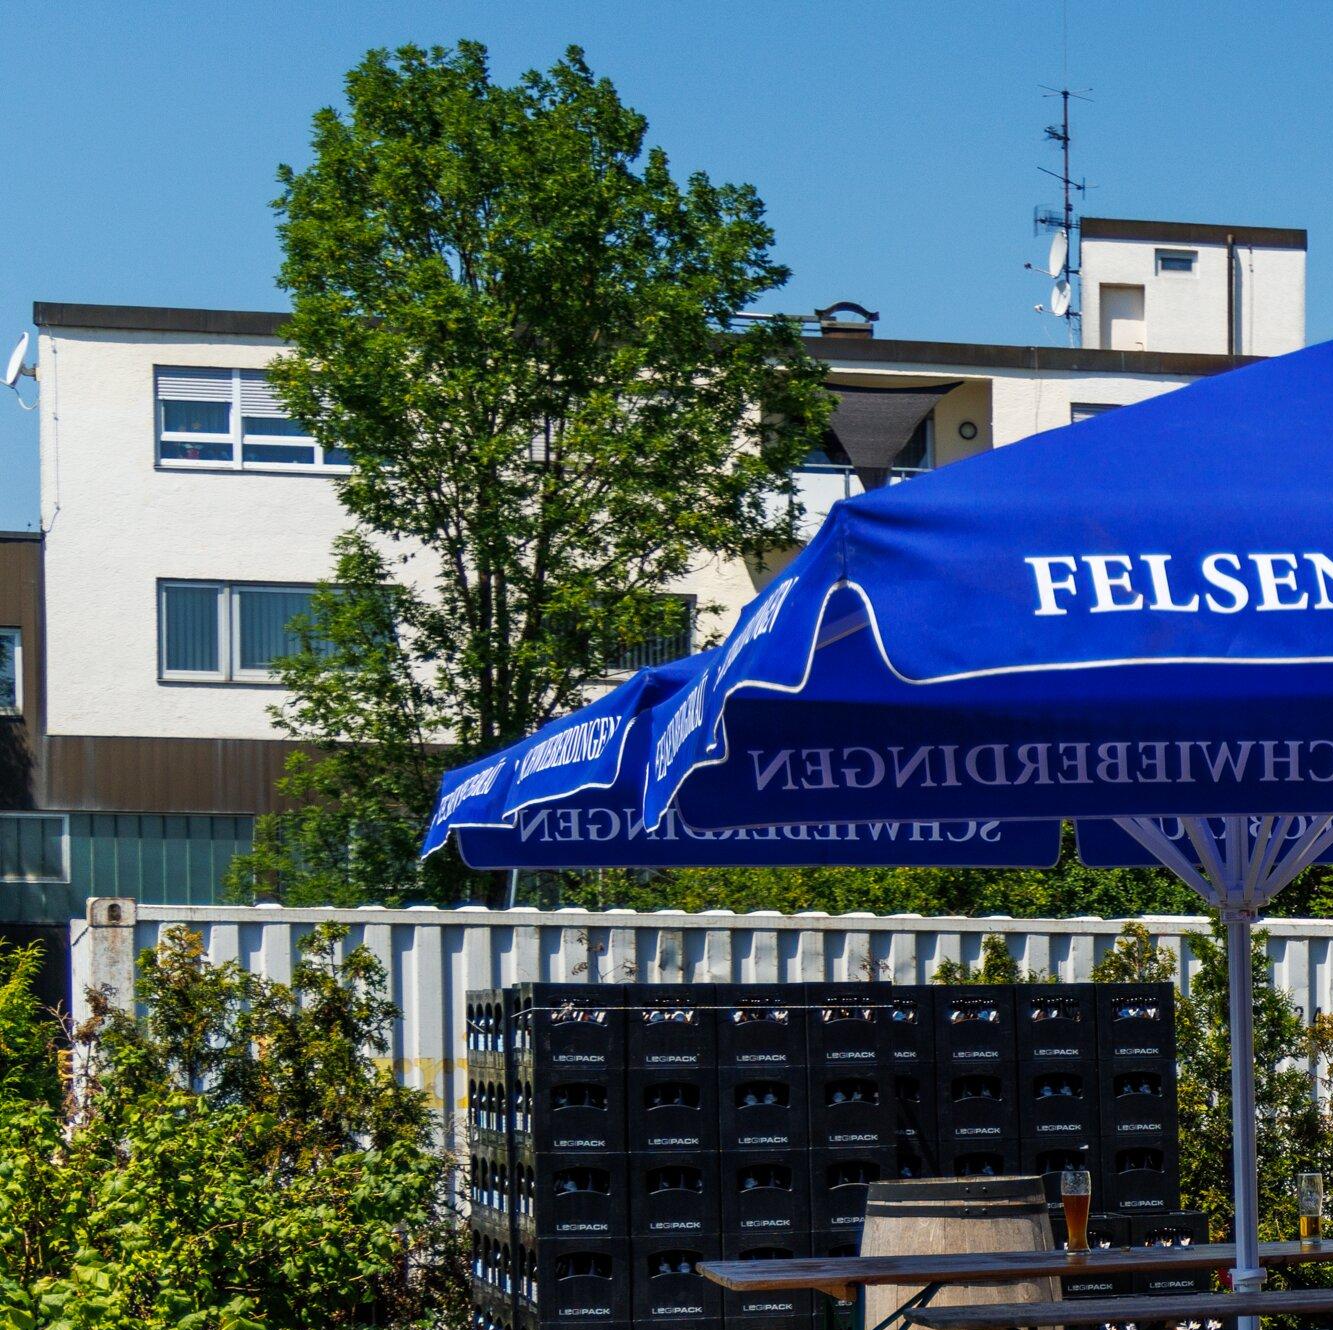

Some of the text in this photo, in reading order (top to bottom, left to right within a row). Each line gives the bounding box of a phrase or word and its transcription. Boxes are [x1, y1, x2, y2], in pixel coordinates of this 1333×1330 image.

[646, 1055, 697, 1063] LEGIPACK
[826, 1051, 875, 1059] LEGIPACK
[1117, 1123, 1161, 1131] LEGIPACK
[738, 1136, 788, 1144] LEGIPACK
[650, 1221, 701, 1229] LEGIPACK
[741, 1219, 790, 1227] LEGIPACK
[1067, 1283, 1112, 1291] LEGIPACK
[1150, 1281, 1194, 1289] LEGIPACK
[652, 1306, 702, 1314] LEGIPACK
[743, 1303, 793, 1312] LEGIPACK
